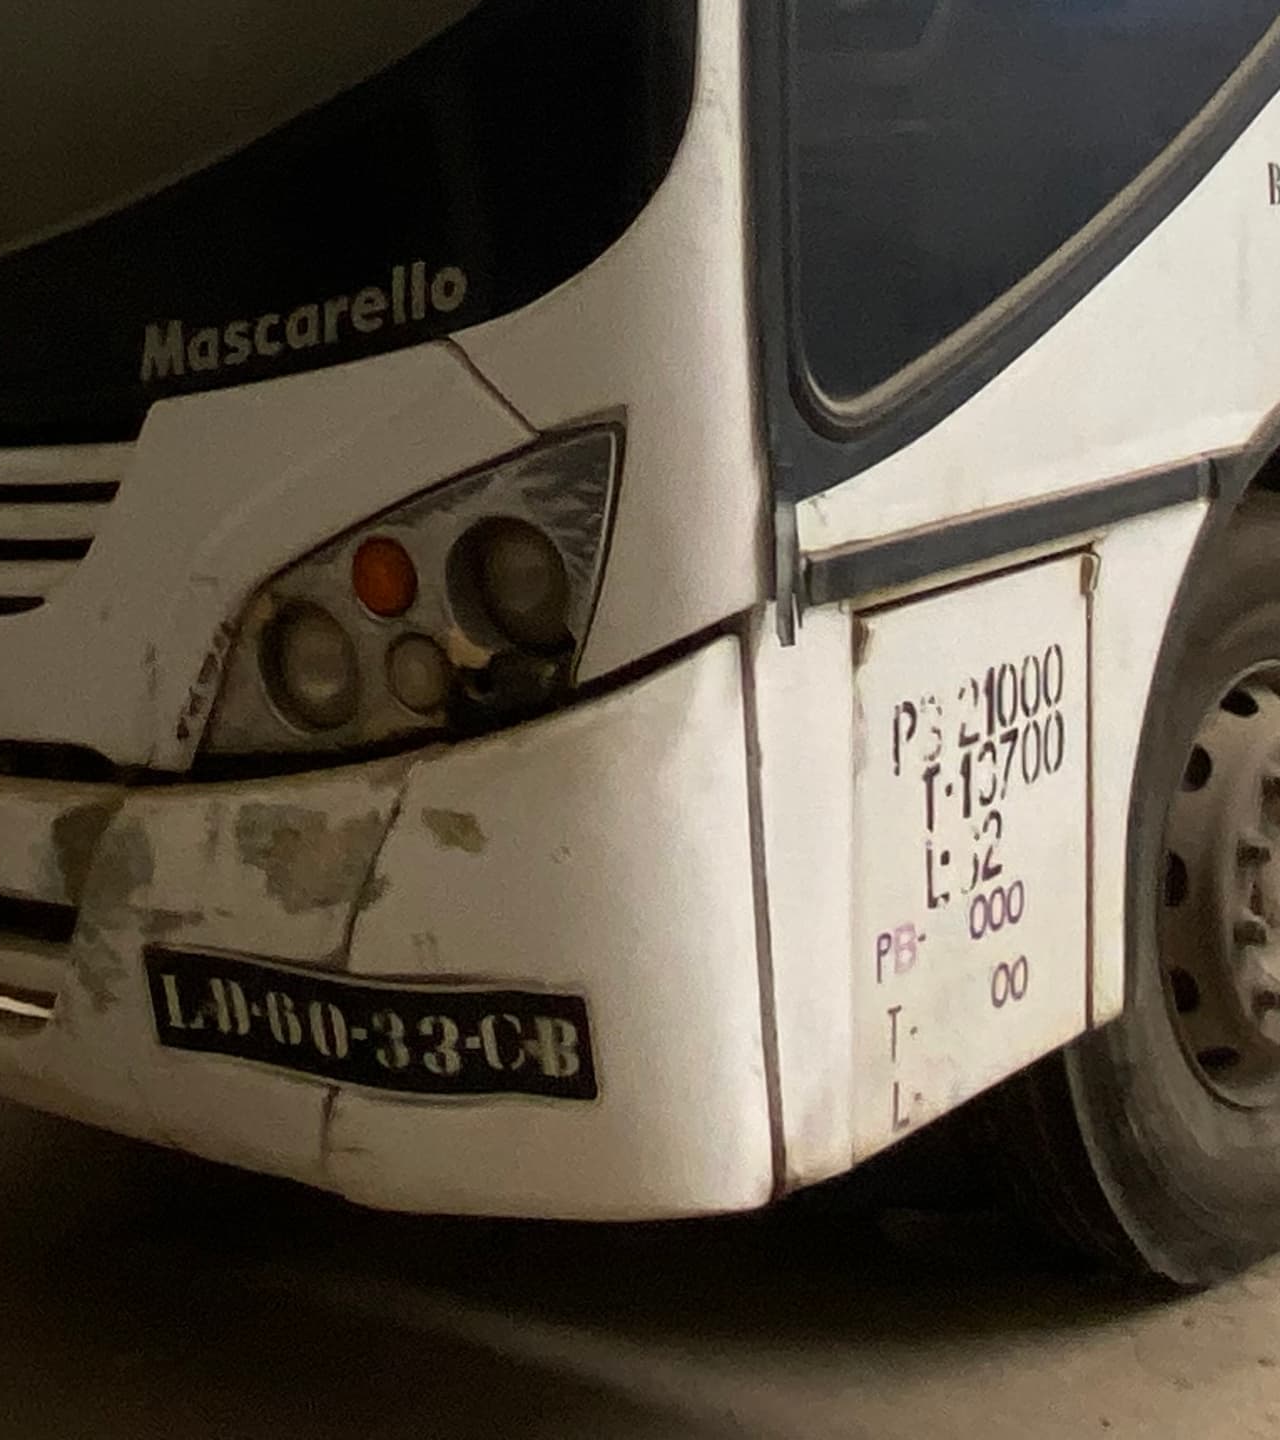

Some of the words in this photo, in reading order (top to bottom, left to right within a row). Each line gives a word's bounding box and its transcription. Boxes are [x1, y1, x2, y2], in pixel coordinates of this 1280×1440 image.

[140, 260, 468, 382] Mascarello
[970, 879, 1025, 941] 000
[991, 954, 1029, 1009] 00
[161, 973, 580, 1079] LD-60-33-CB
